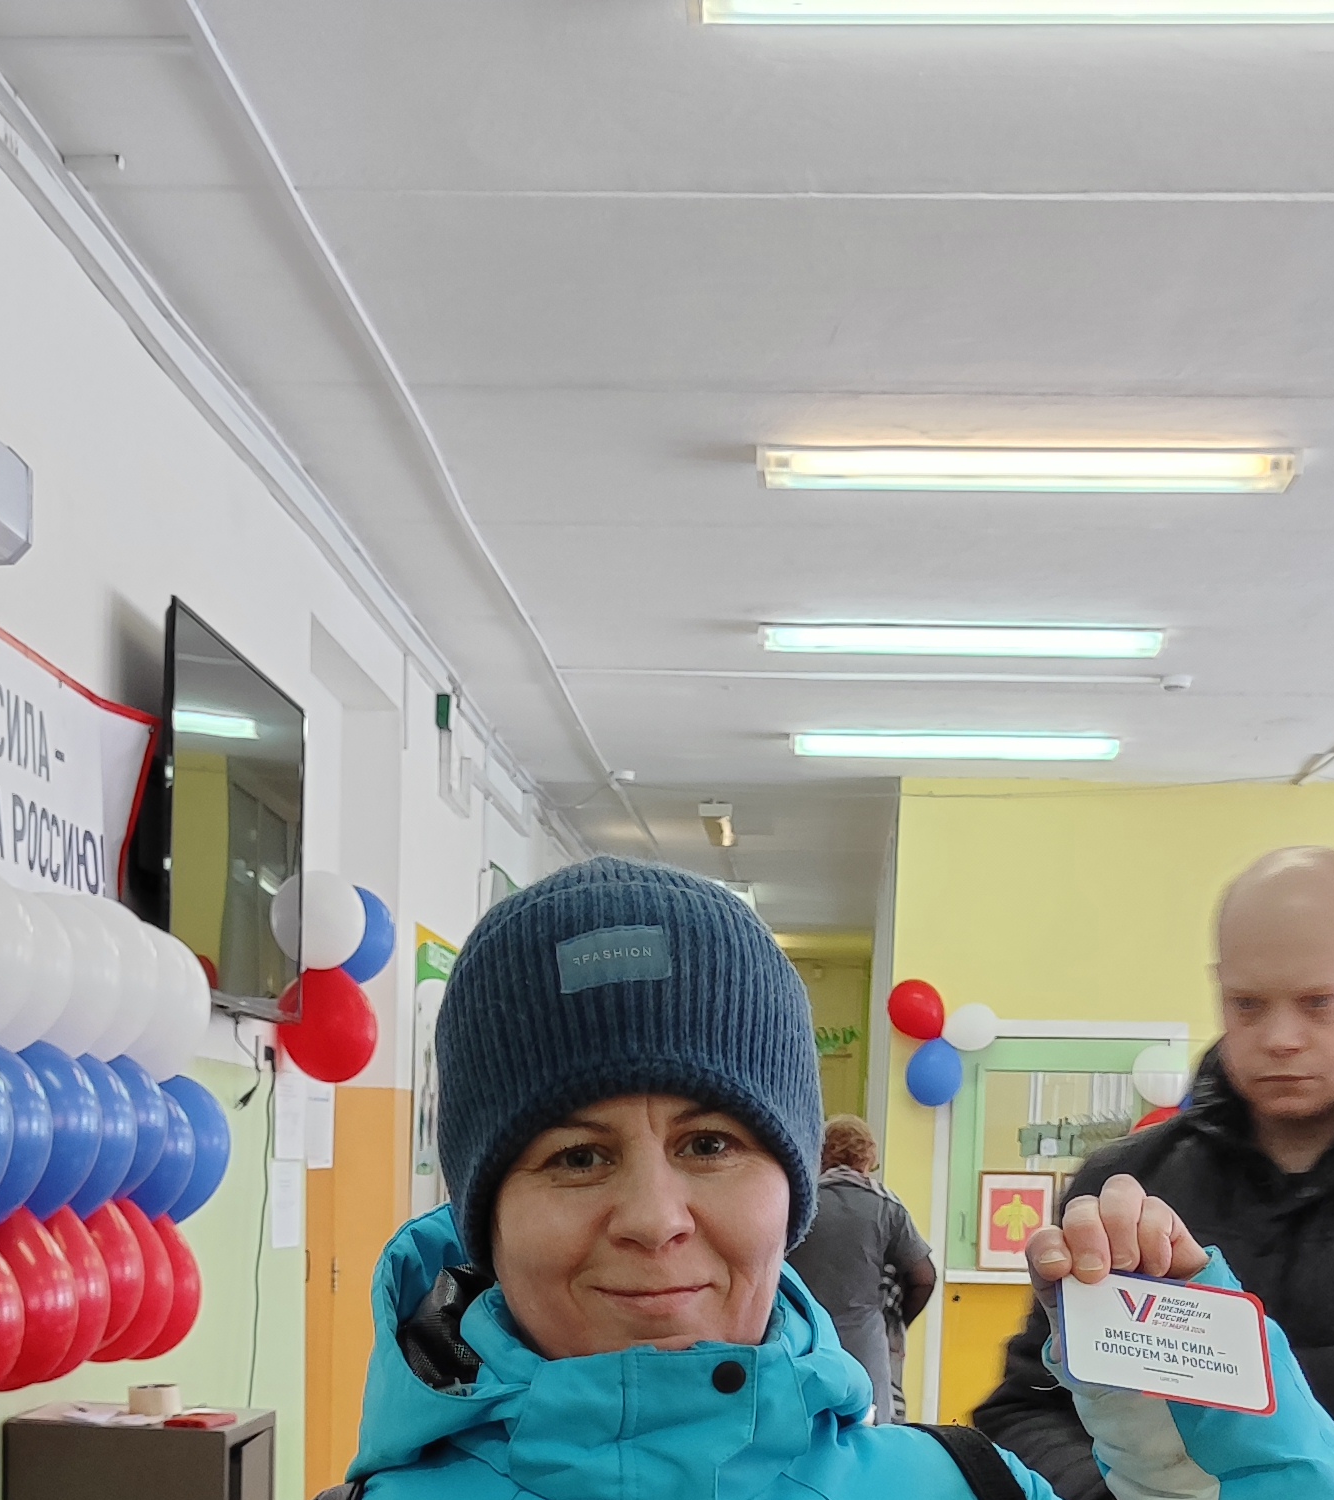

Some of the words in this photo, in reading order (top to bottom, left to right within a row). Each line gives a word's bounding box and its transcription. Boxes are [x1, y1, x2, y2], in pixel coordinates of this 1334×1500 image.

[11, 792, 106, 898] РОССИЮ!
[1157, 1304, 1211, 1320] ПРЕЗИДЕНТА
[1161, 1296, 1199, 1309] ВЫБОРЫ
[1104, 1327, 1153, 1346] ВМЕСТЕ
[1156, 1336, 1178, 1350] МЫ
[1181, 1341, 1215, 1357] СИЛА
[1094, 1340, 1160, 1361] ГОЛОСУЕМ
[1163, 1352, 1179, 1365] ЗА
[1182, 1355, 1239, 1376] РОССИЮ!
